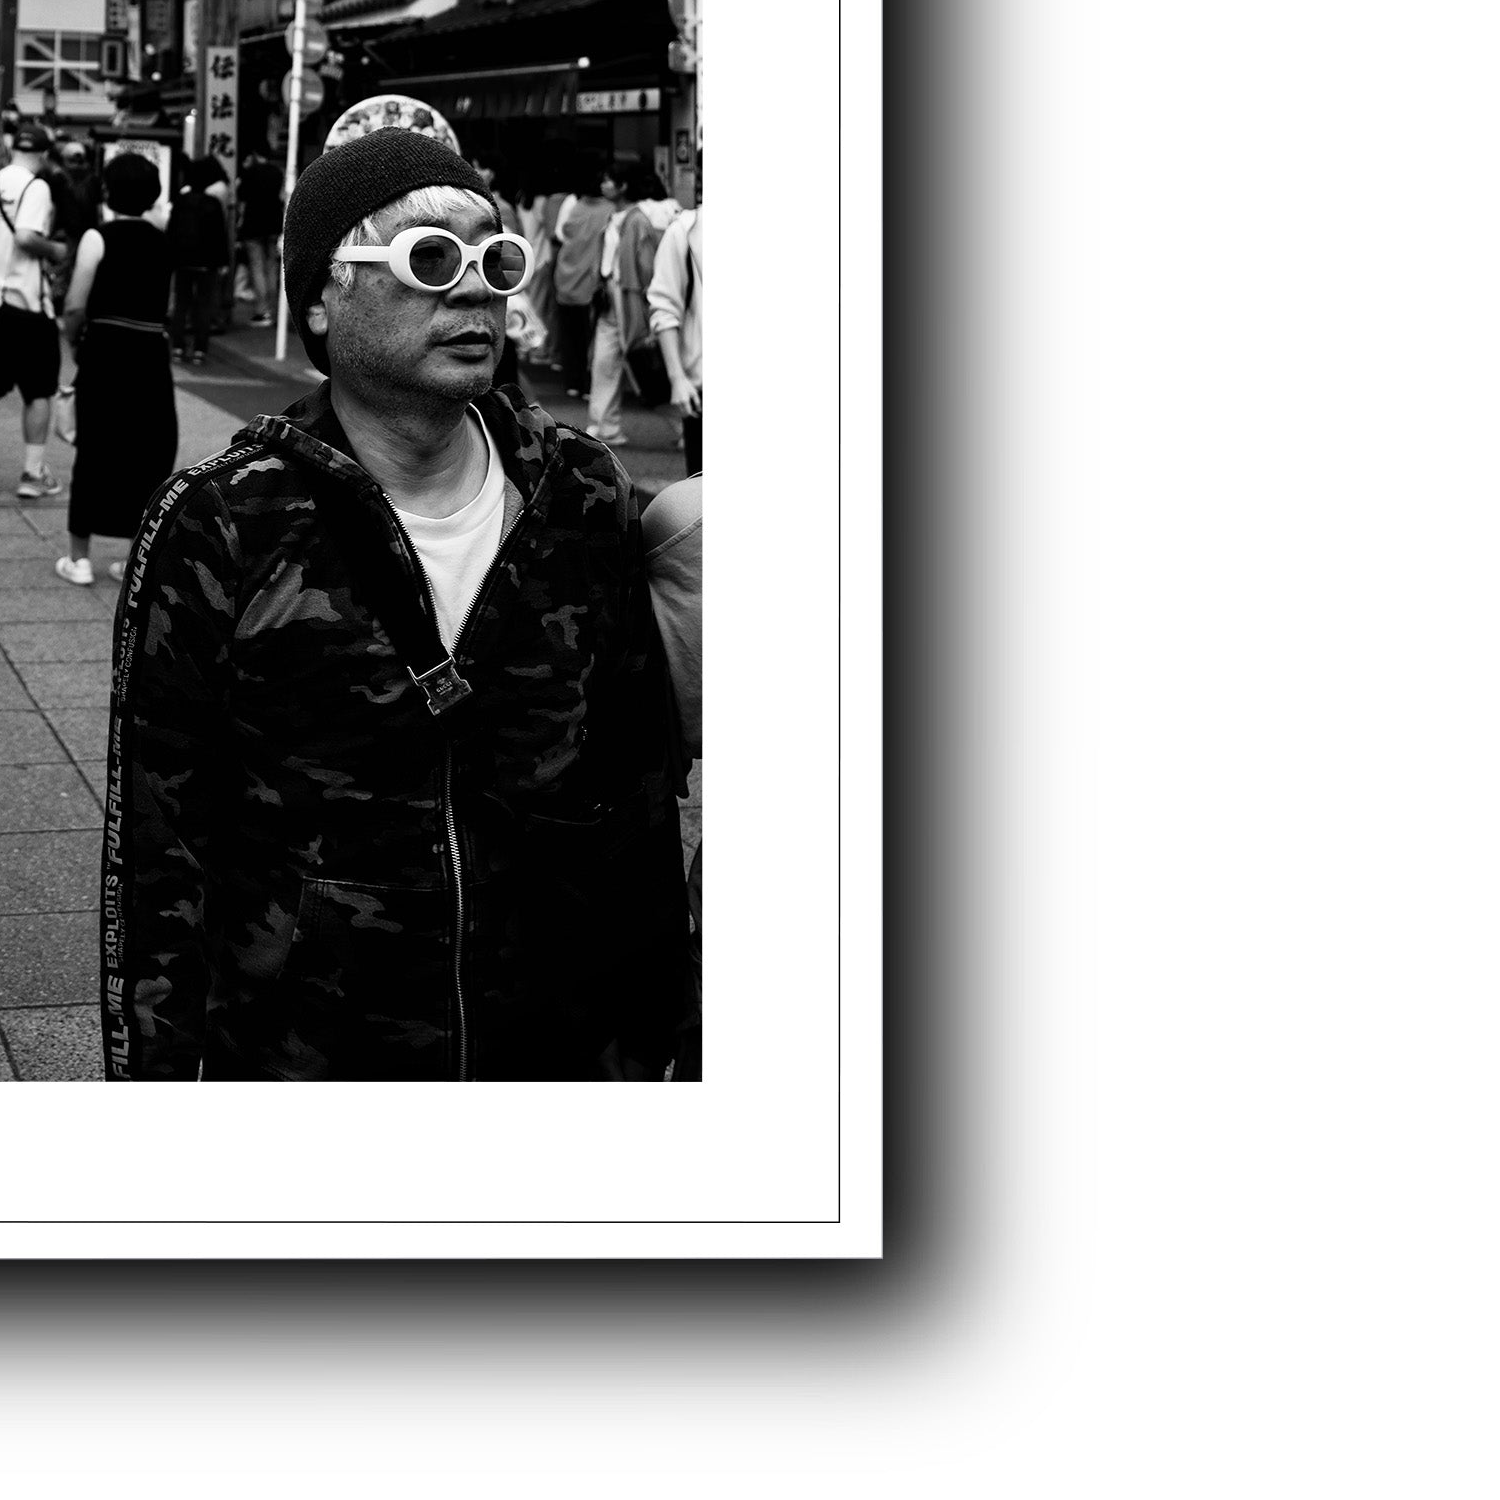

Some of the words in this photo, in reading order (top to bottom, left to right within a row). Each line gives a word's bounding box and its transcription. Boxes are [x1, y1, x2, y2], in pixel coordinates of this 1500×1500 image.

[210, 54, 235, 159] 伝法院
[127, 478, 190, 609] FULFILL-ME
[124, 626, 138, 668] CONFUSION
[108, 715, 123, 865] FULFILL-ME
[105, 874, 119, 969] EXPLOITS
